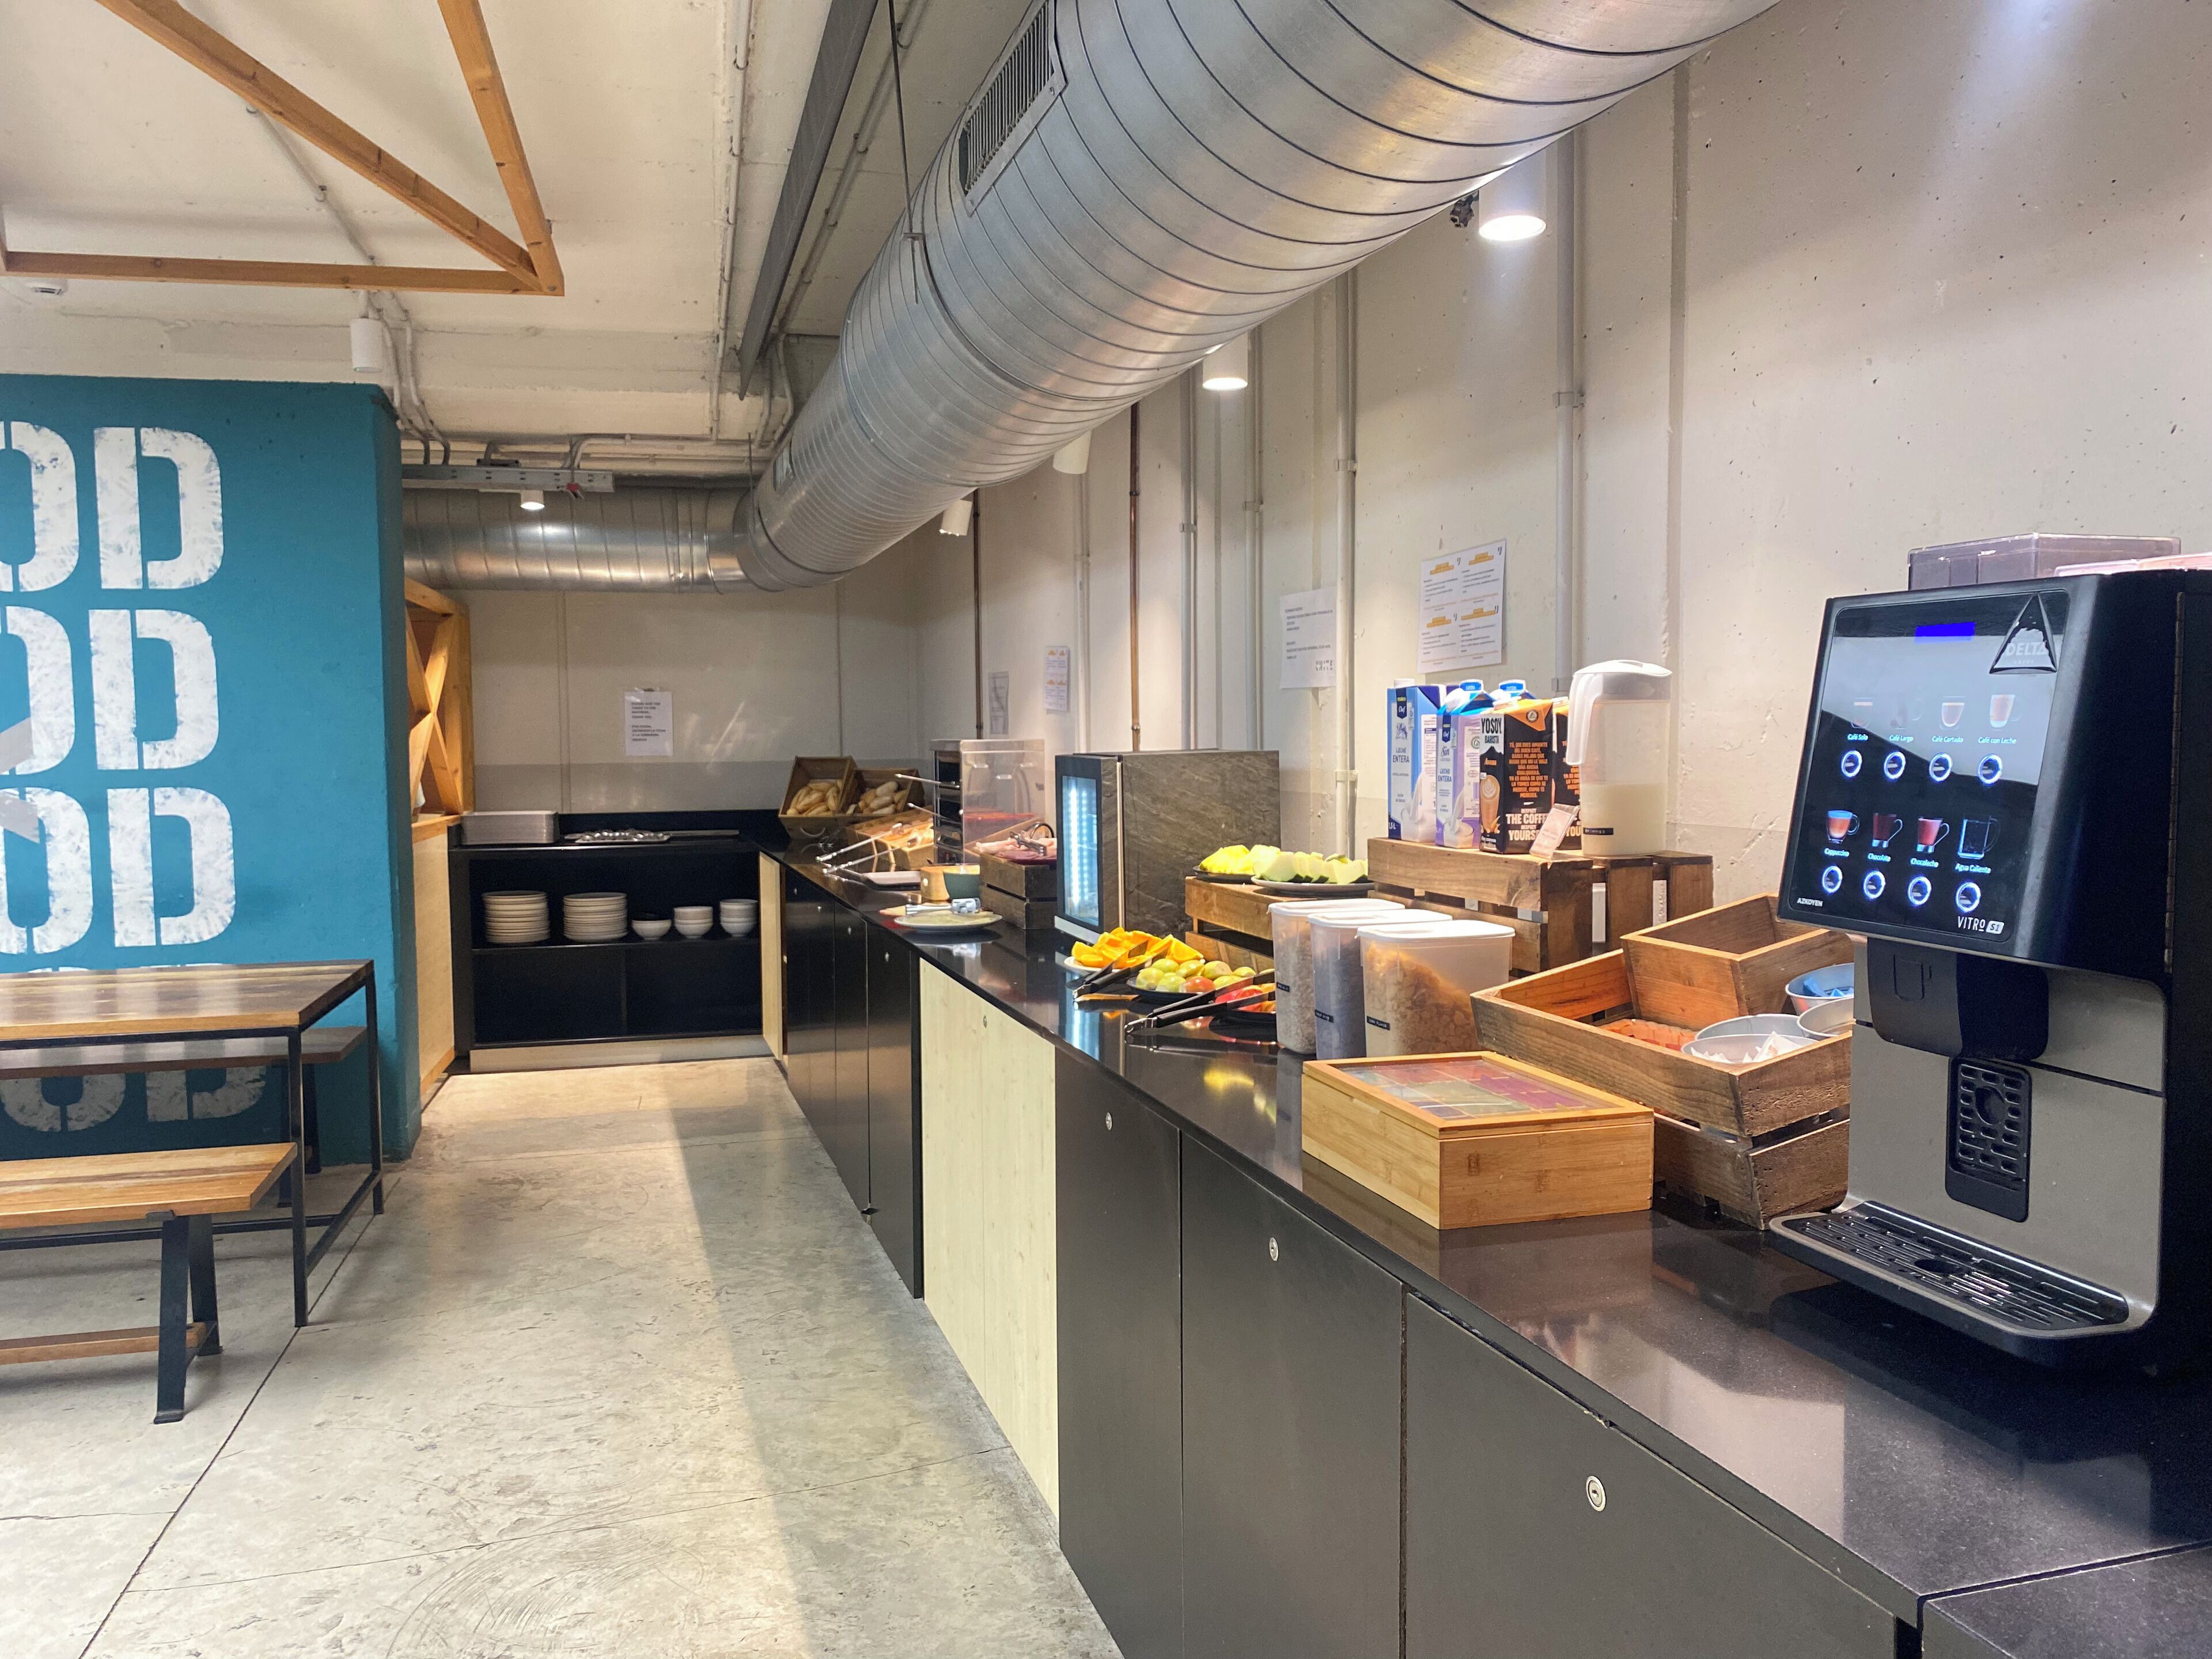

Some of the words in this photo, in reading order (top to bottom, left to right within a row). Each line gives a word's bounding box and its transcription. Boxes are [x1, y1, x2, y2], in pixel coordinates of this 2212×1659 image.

[2006, 642, 2048, 656] DELTA
[1481, 718, 1502, 734] YOSOY
[1484, 736, 1499, 744] BARISTA
[1901, 735, 1914, 743] Largo
[1441, 745, 1450, 756] Sin
[1392, 755, 1410, 763] ENTERA
[1505, 813, 1522, 824] THE
[1955, 863, 1969, 872] Agua
[1969, 865, 1991, 874] Caliente
[1797, 897, 1823, 907] AZKOYEN
[1990, 923, 2000, 931] S1
